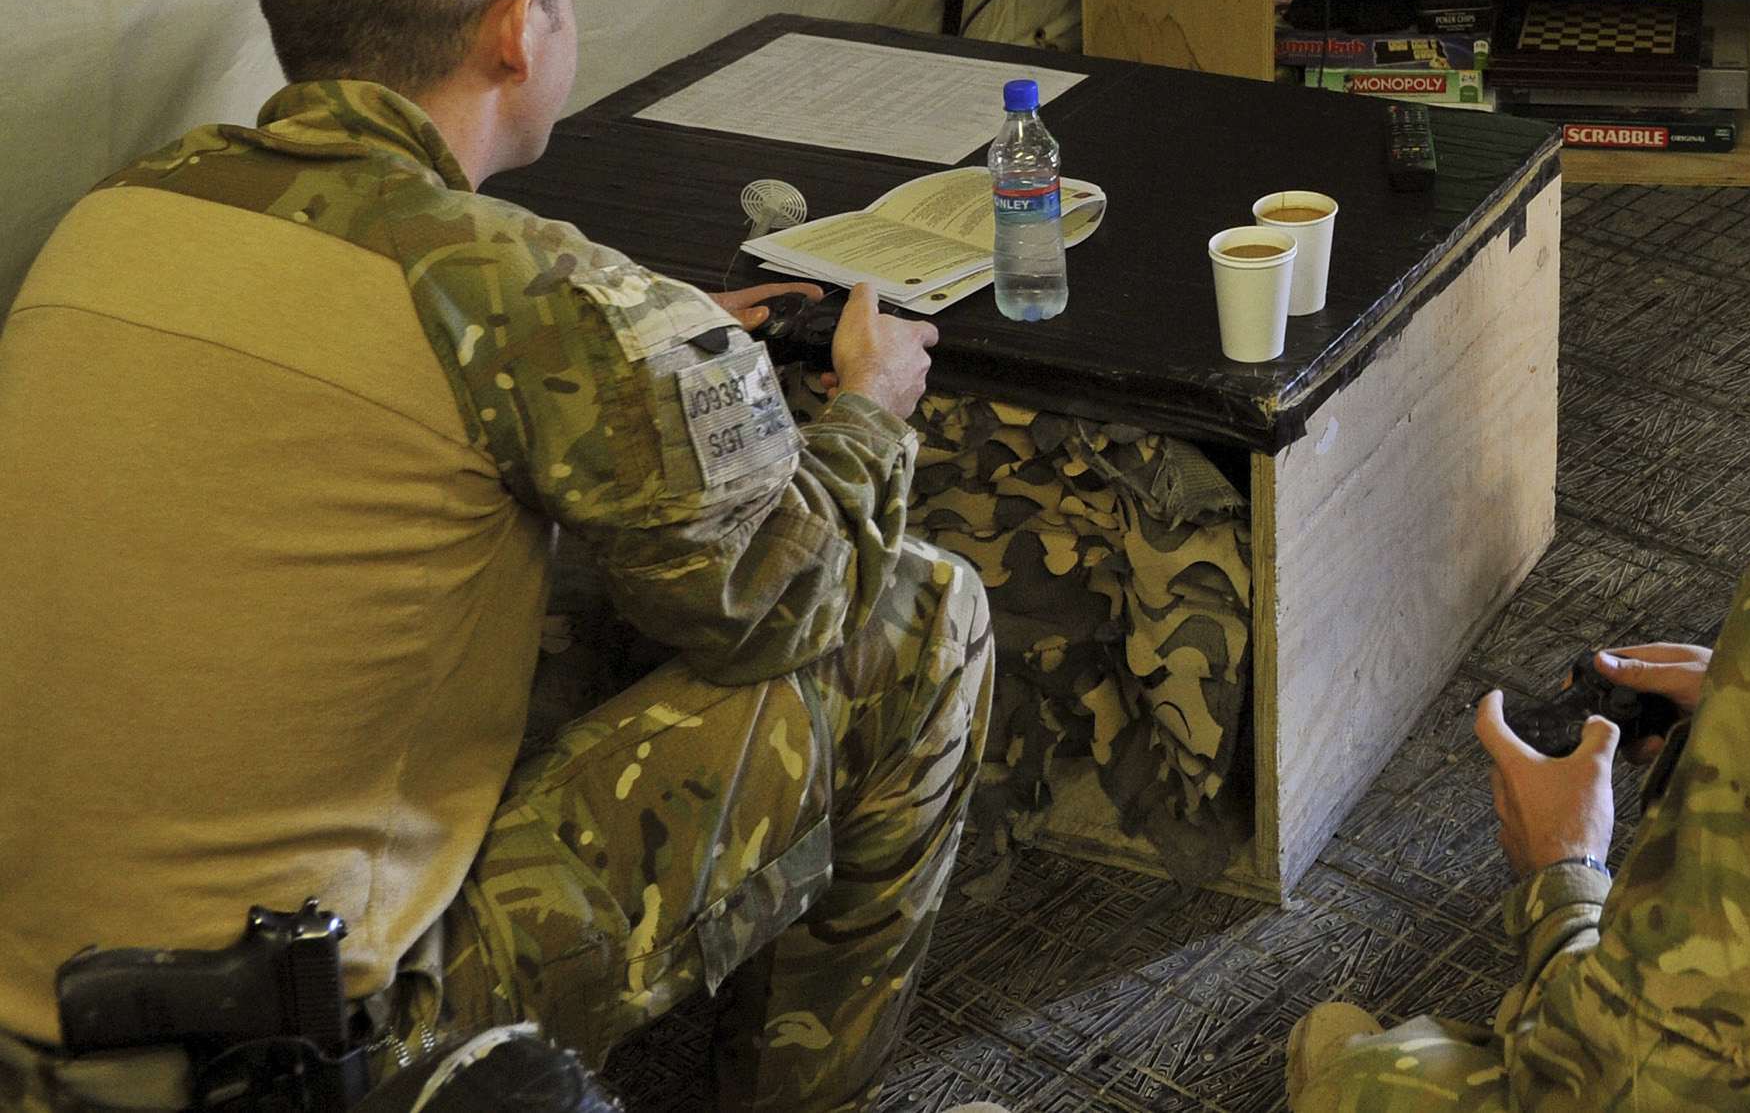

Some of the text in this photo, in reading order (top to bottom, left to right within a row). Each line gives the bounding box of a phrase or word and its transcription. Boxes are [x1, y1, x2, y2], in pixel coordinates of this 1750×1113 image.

[1353, 75, 1443, 92] MONOPOLY
[1567, 128, 1665, 145] SCRABBLE
[708, 423, 744, 458] SGT
